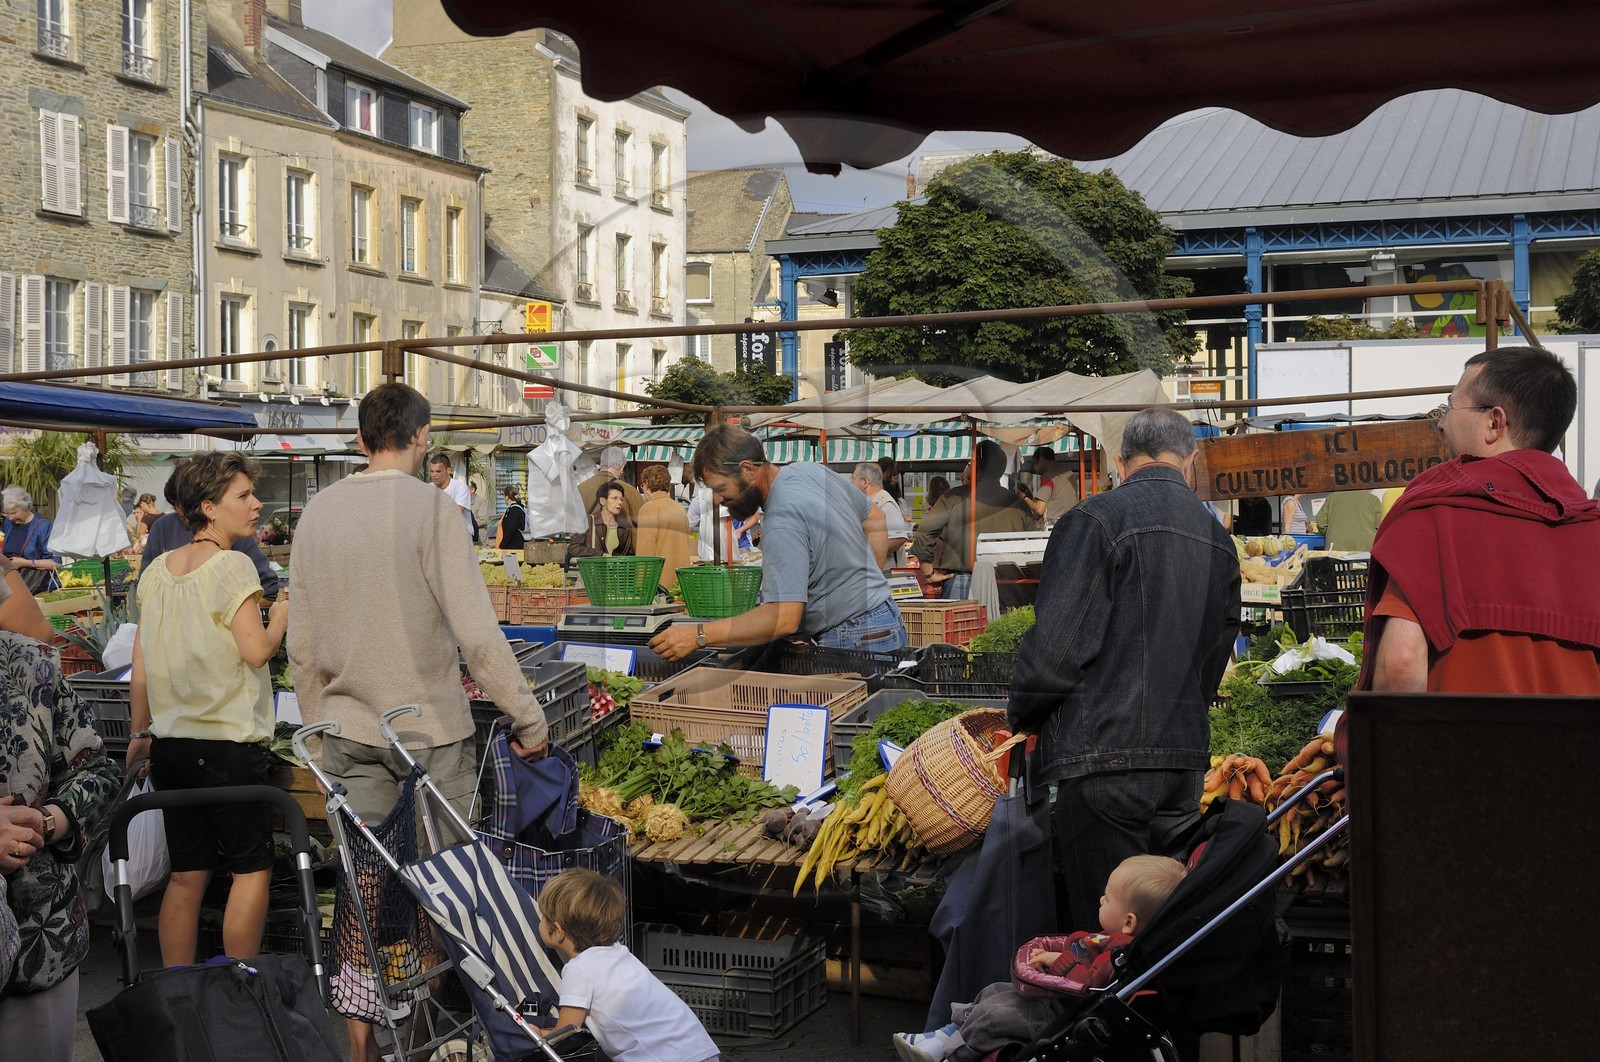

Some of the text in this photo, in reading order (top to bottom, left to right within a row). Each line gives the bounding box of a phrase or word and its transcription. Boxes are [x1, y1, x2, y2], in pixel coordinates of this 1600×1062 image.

[509, 425, 547, 443] PHOTO
[1324, 431, 1358, 455] ICI
[1215, 467, 1308, 494] CULTURE
